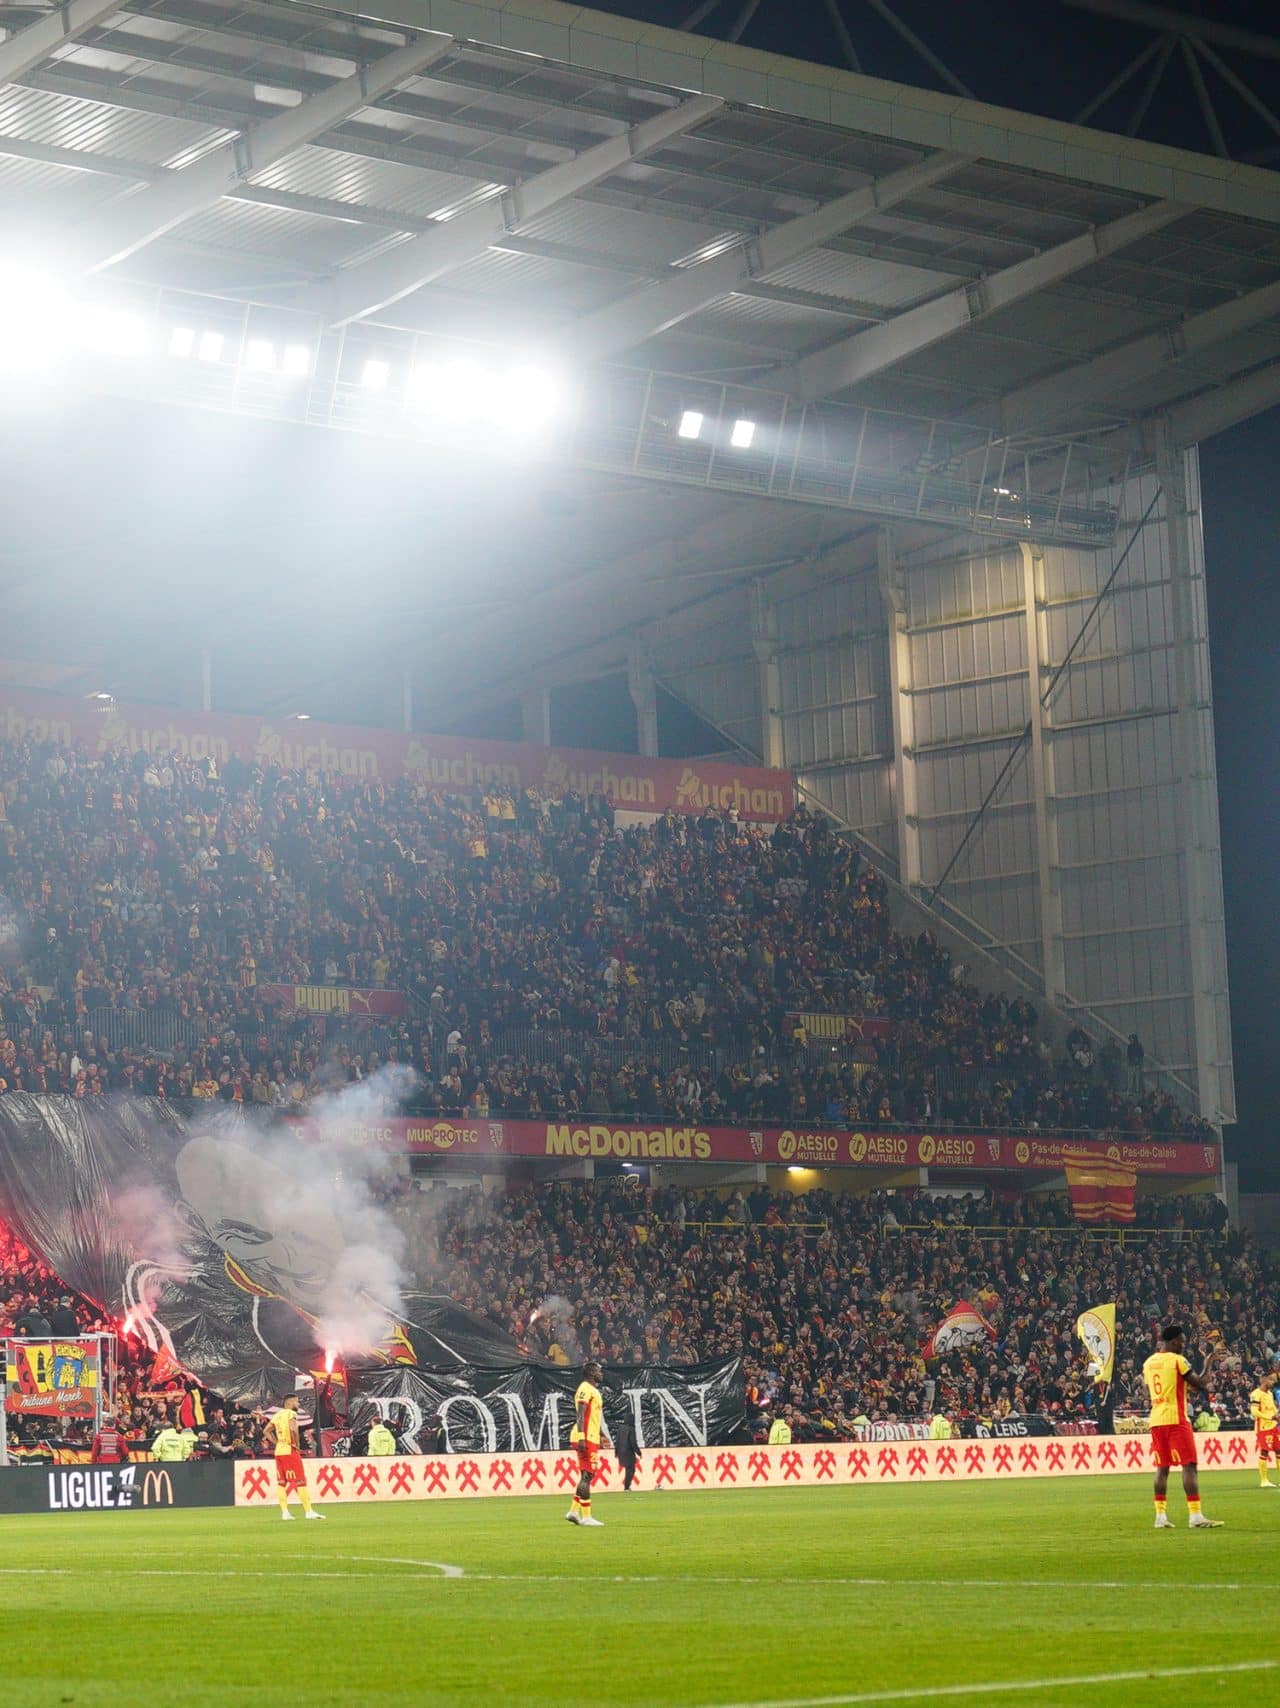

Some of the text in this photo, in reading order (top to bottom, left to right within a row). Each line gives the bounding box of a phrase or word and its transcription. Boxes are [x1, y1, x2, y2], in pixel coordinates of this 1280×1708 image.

[256, 726, 379, 777] Auchan
[544, 753, 657, 803] Auchan
[676, 767, 784, 813] Auchan
[294, 986, 350, 1013] PUMA
[407, 1126, 480, 1145] MURPROTEC
[545, 1124, 713, 1159] McDonald's
[797, 1151, 836, 1160] MUTUELLE
[868, 1153, 905, 1162] MUTUELLE
[936, 1155, 973, 1164] MUTUELLE
[1122, 1146, 1177, 1159] Pas-de-Calais
[1152, 1374, 1163, 1395] 6
[20, 1394, 53, 1407] Tribune
[368, 1383, 715, 1455] ROMIN
[994, 1422, 1028, 1437] LENS
[48, 1471, 115, 1509] LIGUE
